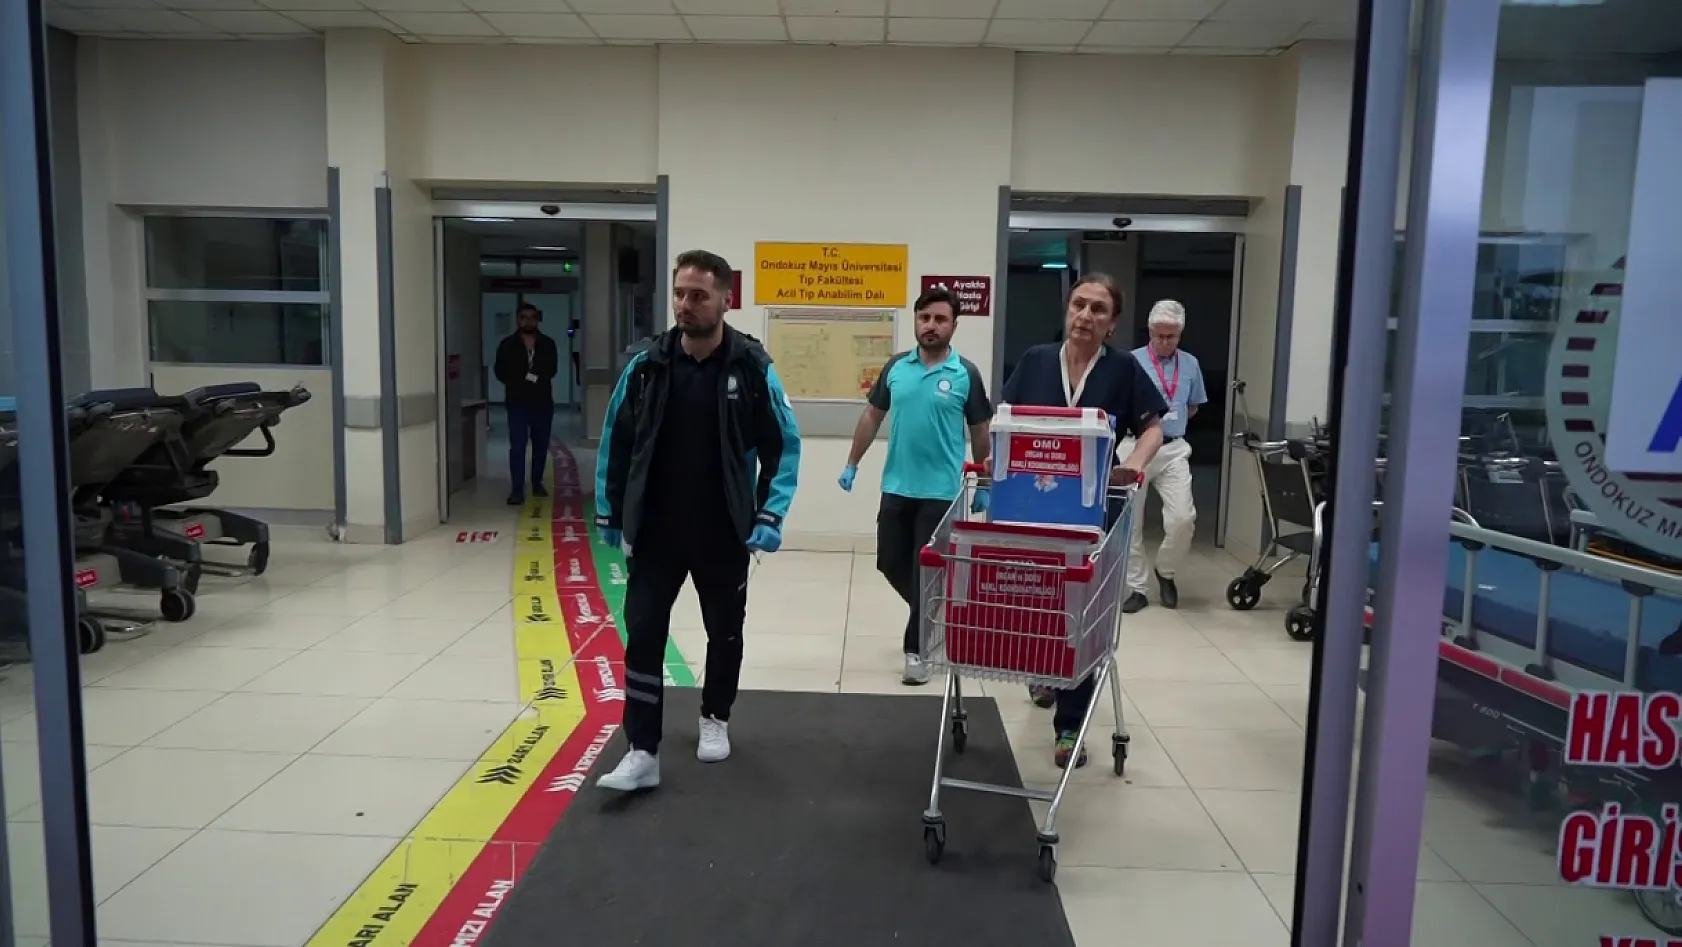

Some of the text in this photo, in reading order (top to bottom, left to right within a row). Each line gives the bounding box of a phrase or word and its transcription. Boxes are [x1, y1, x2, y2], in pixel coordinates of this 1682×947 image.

[760, 258, 903, 273] Ondokuz Mayıs Üniversitesi
[822, 247, 841, 258] T.C.
[799, 275, 864, 286] Tıp Fakültesi
[952, 280, 986, 290] Ayakta
[776, 288, 885, 300] Acil Tıp Anabilim Dalı
[1574, 441, 1655, 528] ONDOKUZ
[1565, 691, 1682, 769] HAS
[1558, 802, 1682, 900] GİRİ
[371, 884, 420, 922] ALAN
[472, 880, 514, 919] ALAN
